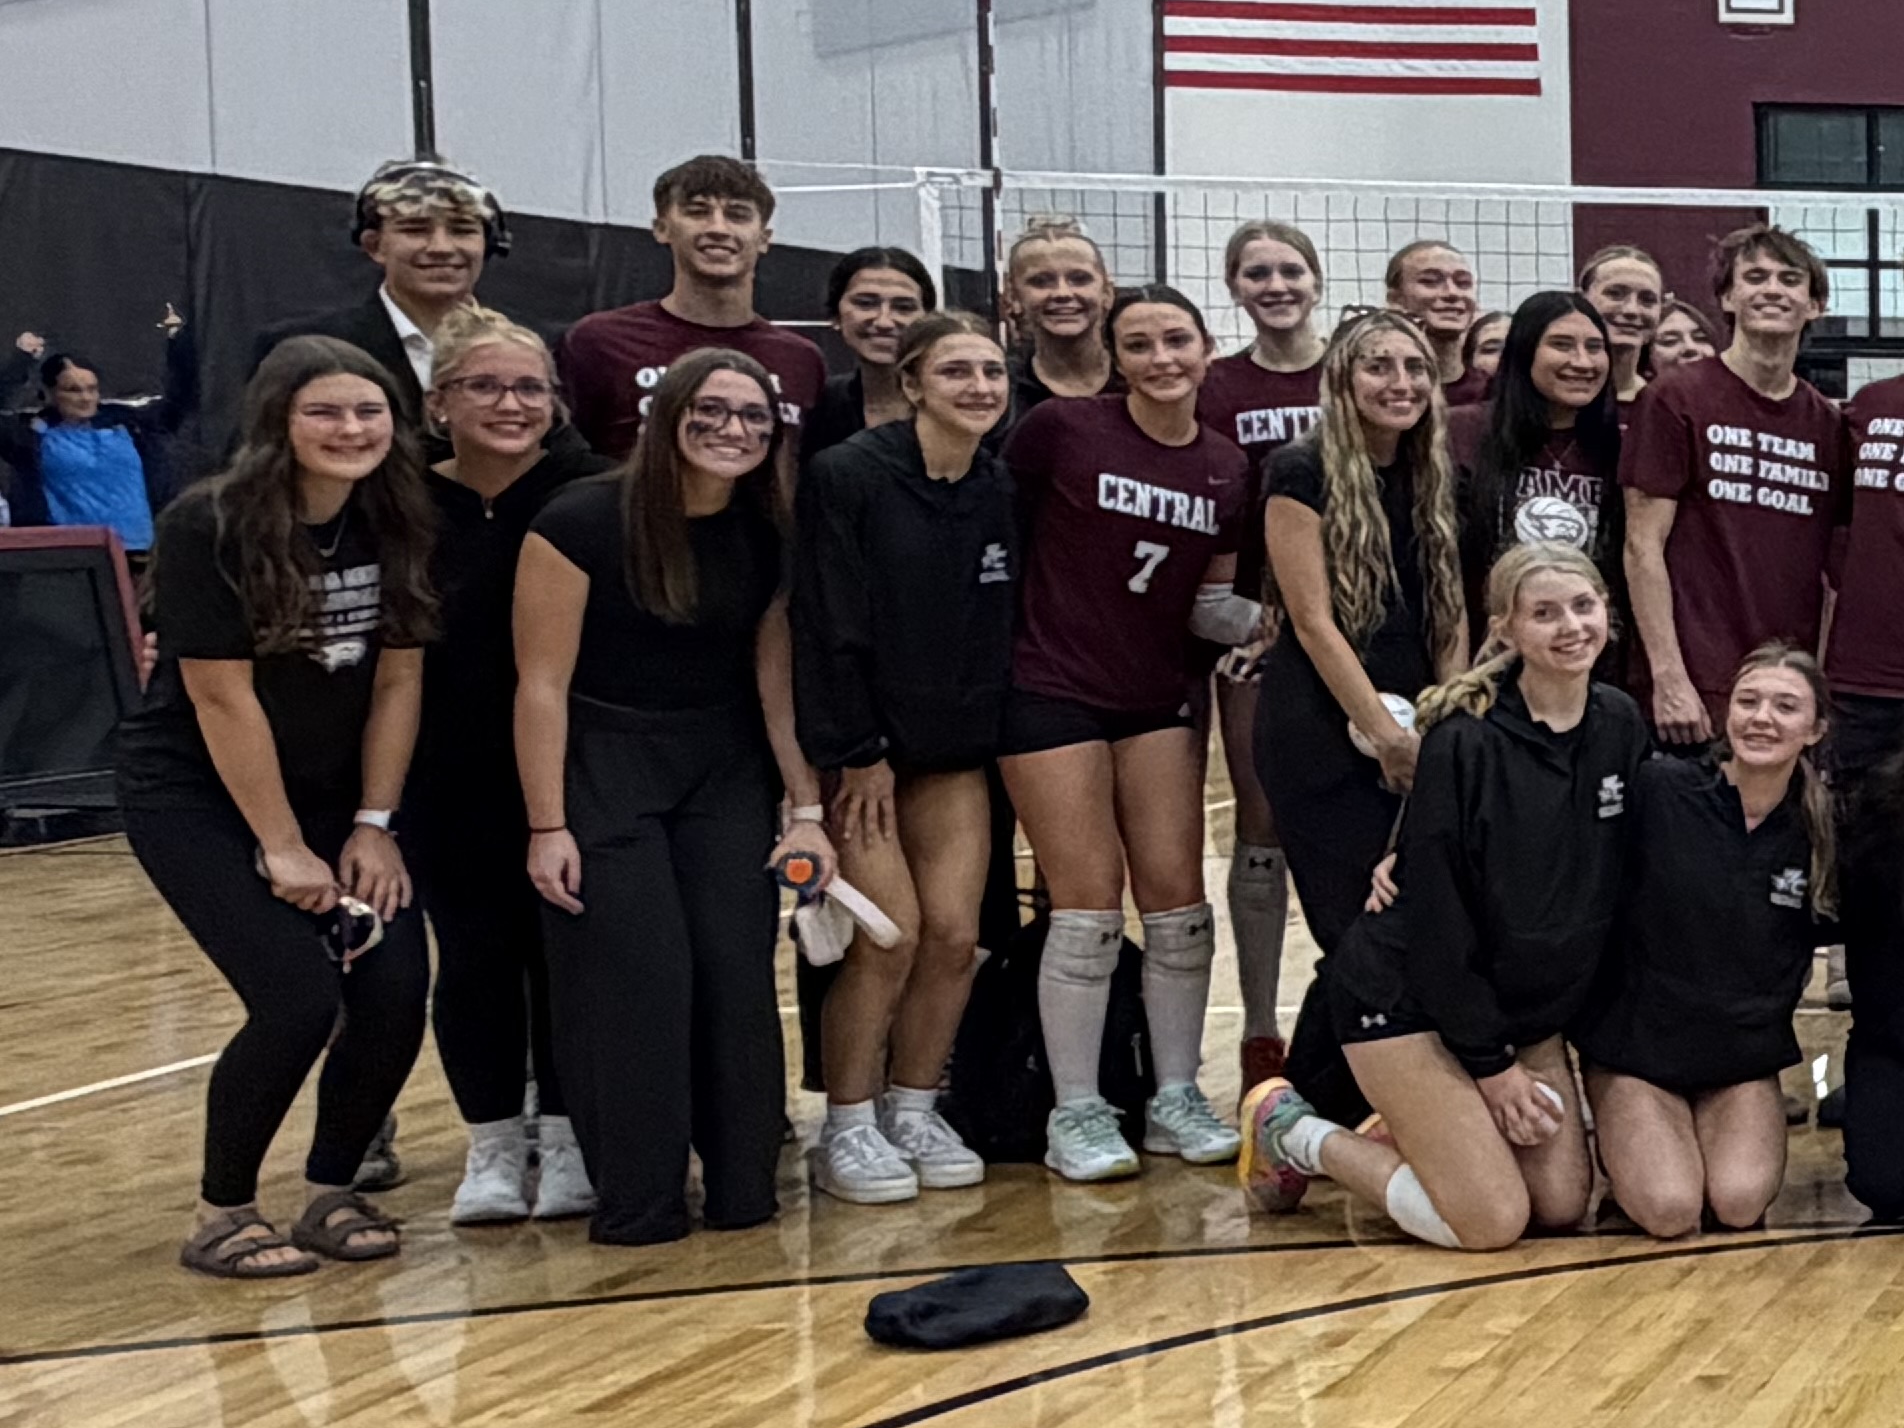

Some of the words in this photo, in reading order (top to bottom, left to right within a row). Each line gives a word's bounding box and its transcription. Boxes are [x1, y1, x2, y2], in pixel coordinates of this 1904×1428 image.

[1706, 423, 1753, 448] ONE
[1757, 431, 1816, 462] TEAM
[1709, 451, 1754, 476] ONE
[1098, 472, 1221, 536] CENTRAL
[1708, 478, 1753, 504] ONE
[1757, 485, 1814, 516] GOAL
[1126, 539, 1171, 595] 7
